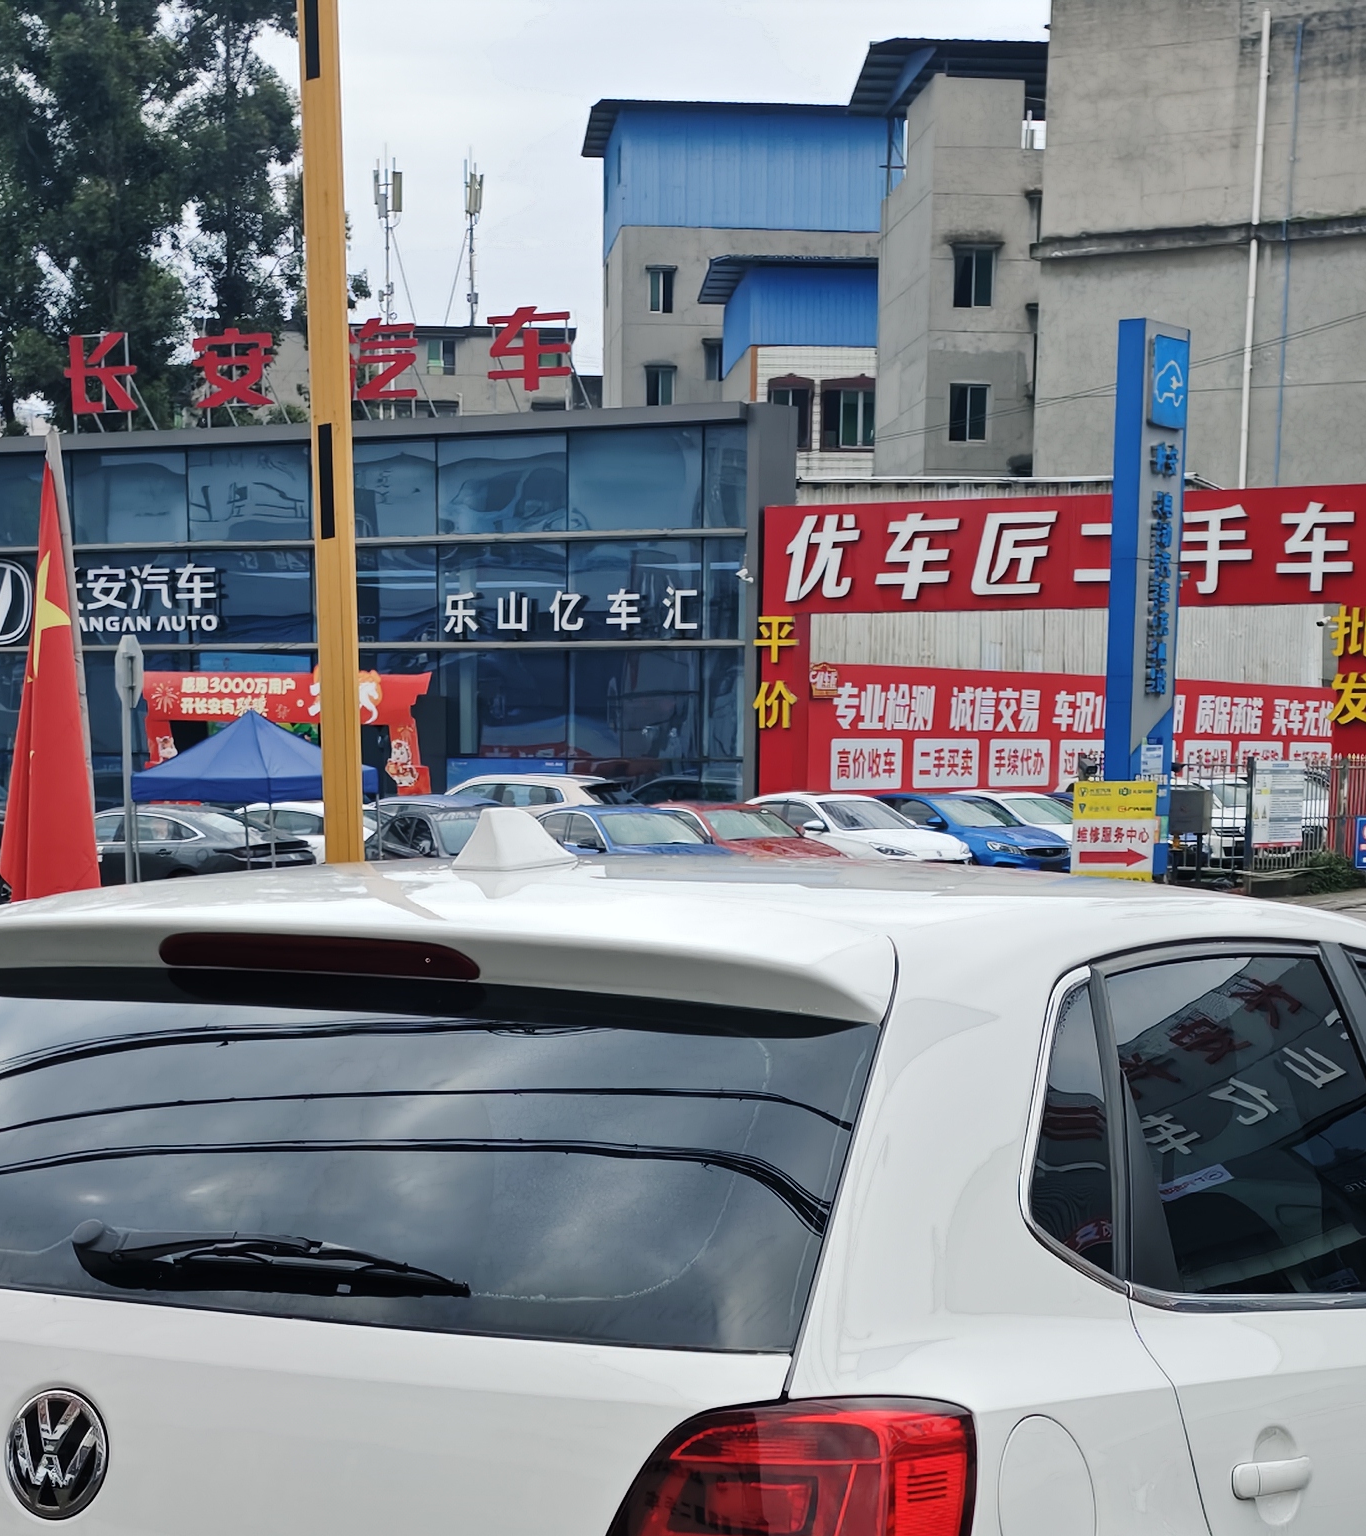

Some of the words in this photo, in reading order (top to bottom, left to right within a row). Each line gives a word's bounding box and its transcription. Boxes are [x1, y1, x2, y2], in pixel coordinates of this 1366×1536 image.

[64, 306, 572, 414] 长安汽车
[75, 563, 217, 610] 安汽车
[157, 615, 218, 632] AUTO
[444, 586, 698, 634] 乐山亿车汇
[753, 616, 799, 730] 平价
[833, 683, 935, 731] 专业检测
[950, 686, 1041, 733] 诚信交易
[1195, 695, 1264, 735] 质保承诺
[1271, 699, 1334, 737] 买车无忧
[836, 749, 896, 779] 高价收车
[918, 747, 973, 777] 二手买卖
[993, 747, 1046, 777] 手续代办
[1077, 827, 1150, 844] 维修服务中心
